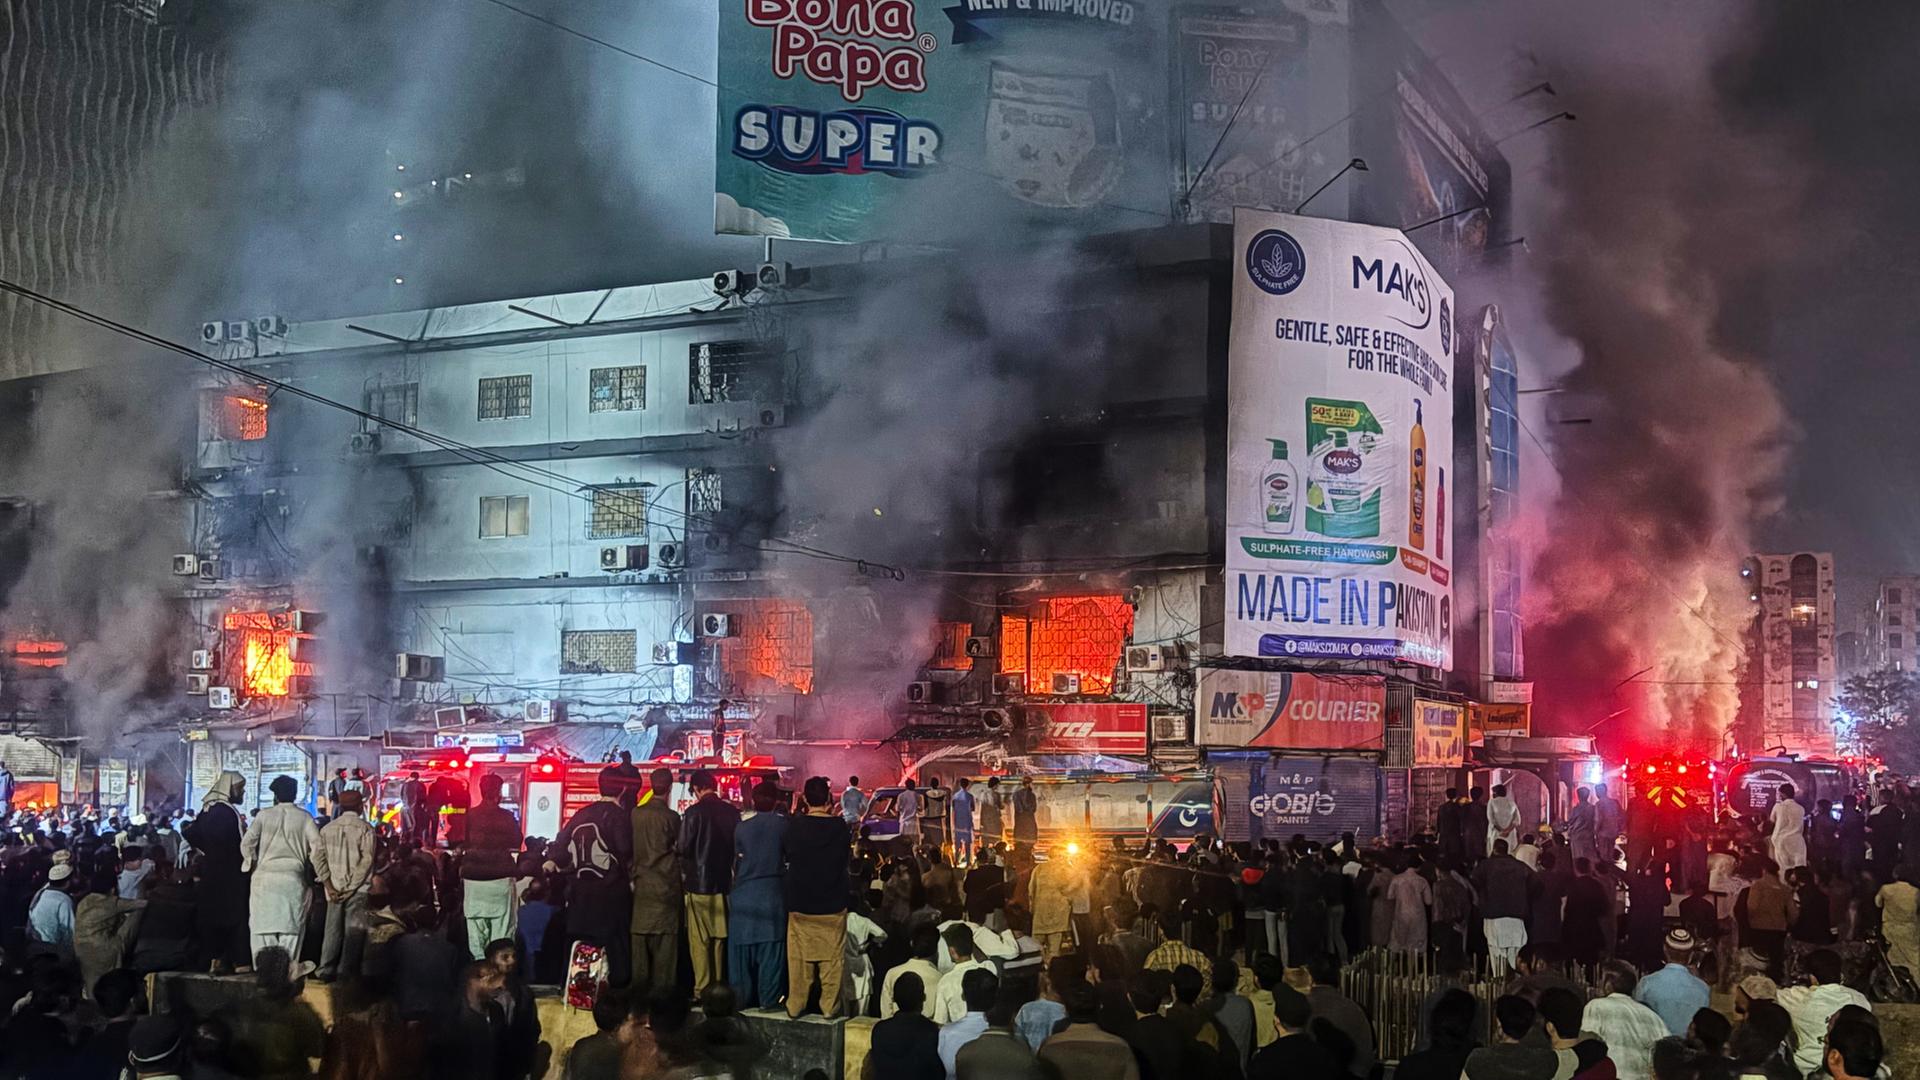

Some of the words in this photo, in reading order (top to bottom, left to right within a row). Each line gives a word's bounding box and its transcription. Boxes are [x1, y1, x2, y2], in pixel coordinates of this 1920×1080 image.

[773, 21, 927, 101] Papa
[738, 107, 941, 168] SUPER
[1252, 267, 1283, 289] SULPHATE
[1283, 274, 1299, 288] FREE
[1352, 255, 1426, 315] MAK'S
[1276, 318, 1332, 347] GENTLE,
[1336, 324, 1369, 348] SAFE
[1373, 332, 1381, 349] &
[1384, 331, 1420, 365] EFFECTIVE
[1348, 349, 1373, 370] FOR
[1376, 352, 1399, 375] THE
[1327, 457, 1359, 468] MAK'S
[1250, 542, 1330, 557] SULPHATE-FREE
[1332, 546, 1389, 560] HANDWASH
[1238, 573, 1332, 625] MADE
[1341, 578, 1369, 626] IN
[1378, 581, 1436, 638] PAKISTAN
[1210, 692, 1265, 719] M&P
[1288, 699, 1381, 723] COURIER
[1052, 721, 1096, 737] TCS
[1280, 776, 1290, 785] M
[1293, 773, 1300, 785] &
[1304, 776, 1313, 785] P
[1250, 790, 1336, 817] GOBI'S
[1276, 816, 1310, 825] PAINTS
